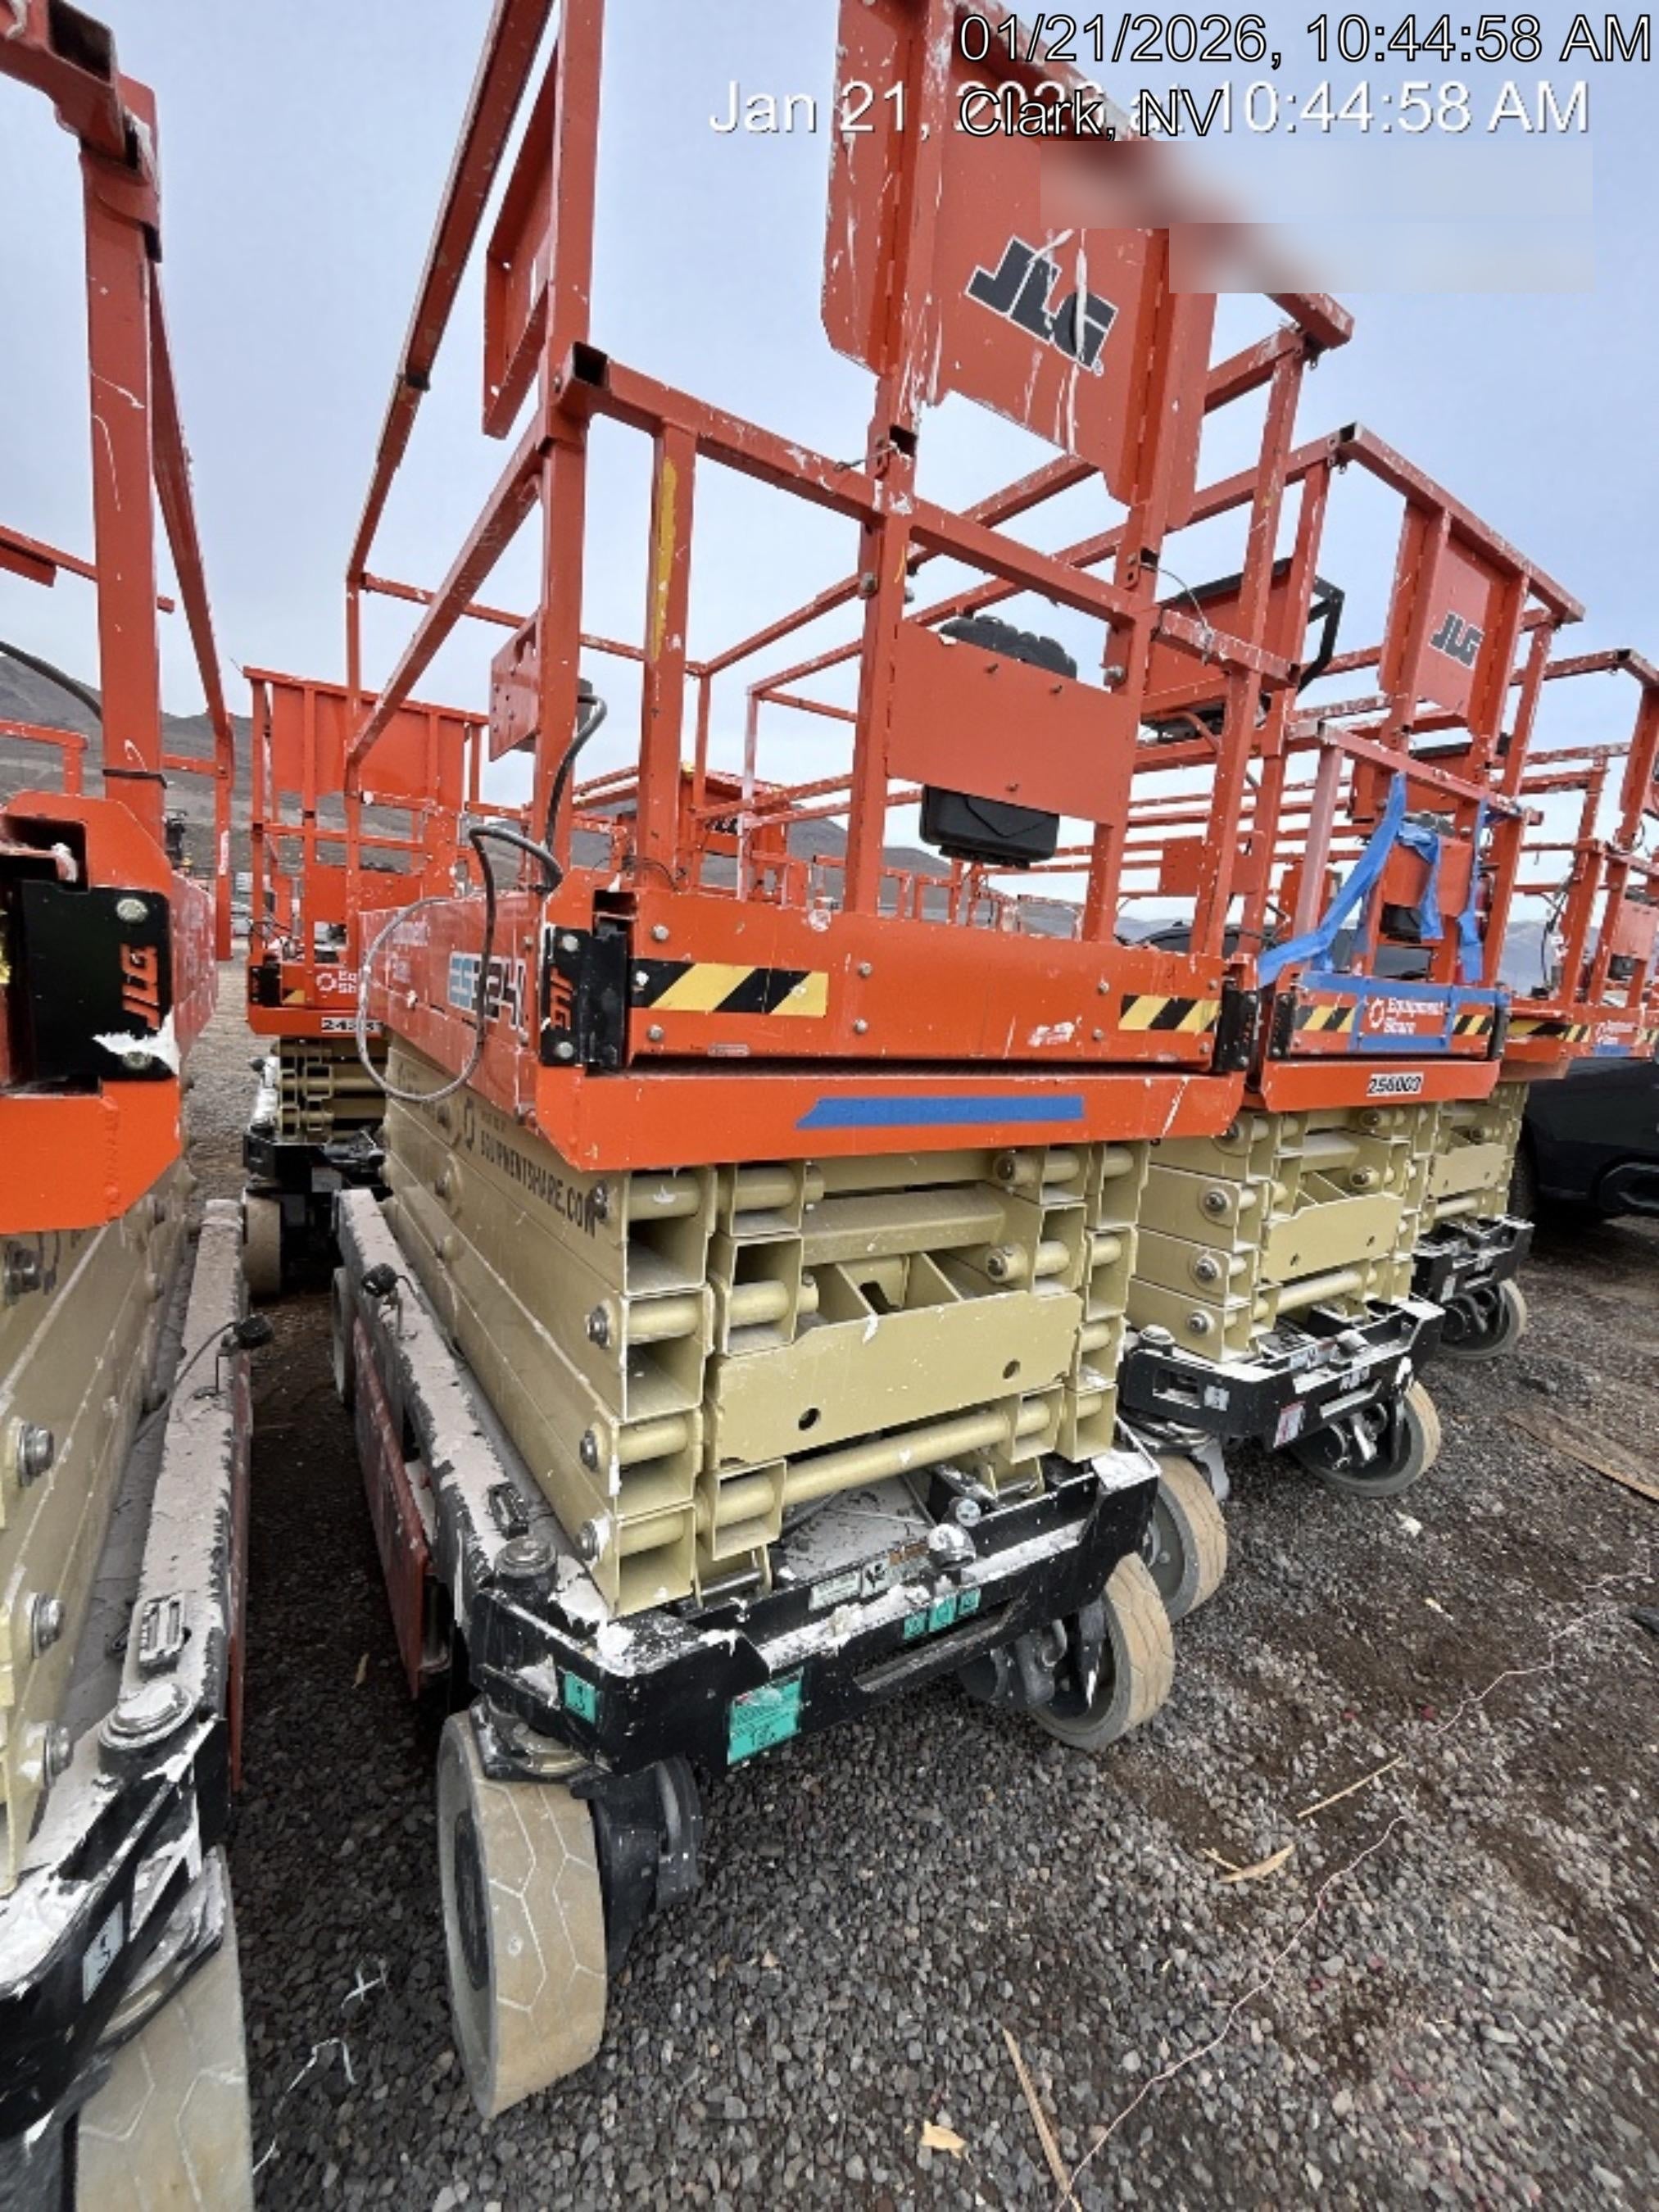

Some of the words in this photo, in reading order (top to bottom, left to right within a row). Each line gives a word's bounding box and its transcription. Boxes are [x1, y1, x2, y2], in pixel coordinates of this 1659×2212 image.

[963, 233, 1119, 373] JLG
[1428, 610, 1485, 669] JLG
[120, 942, 160, 1031] JLG
[550, 965, 573, 1031] JLG
